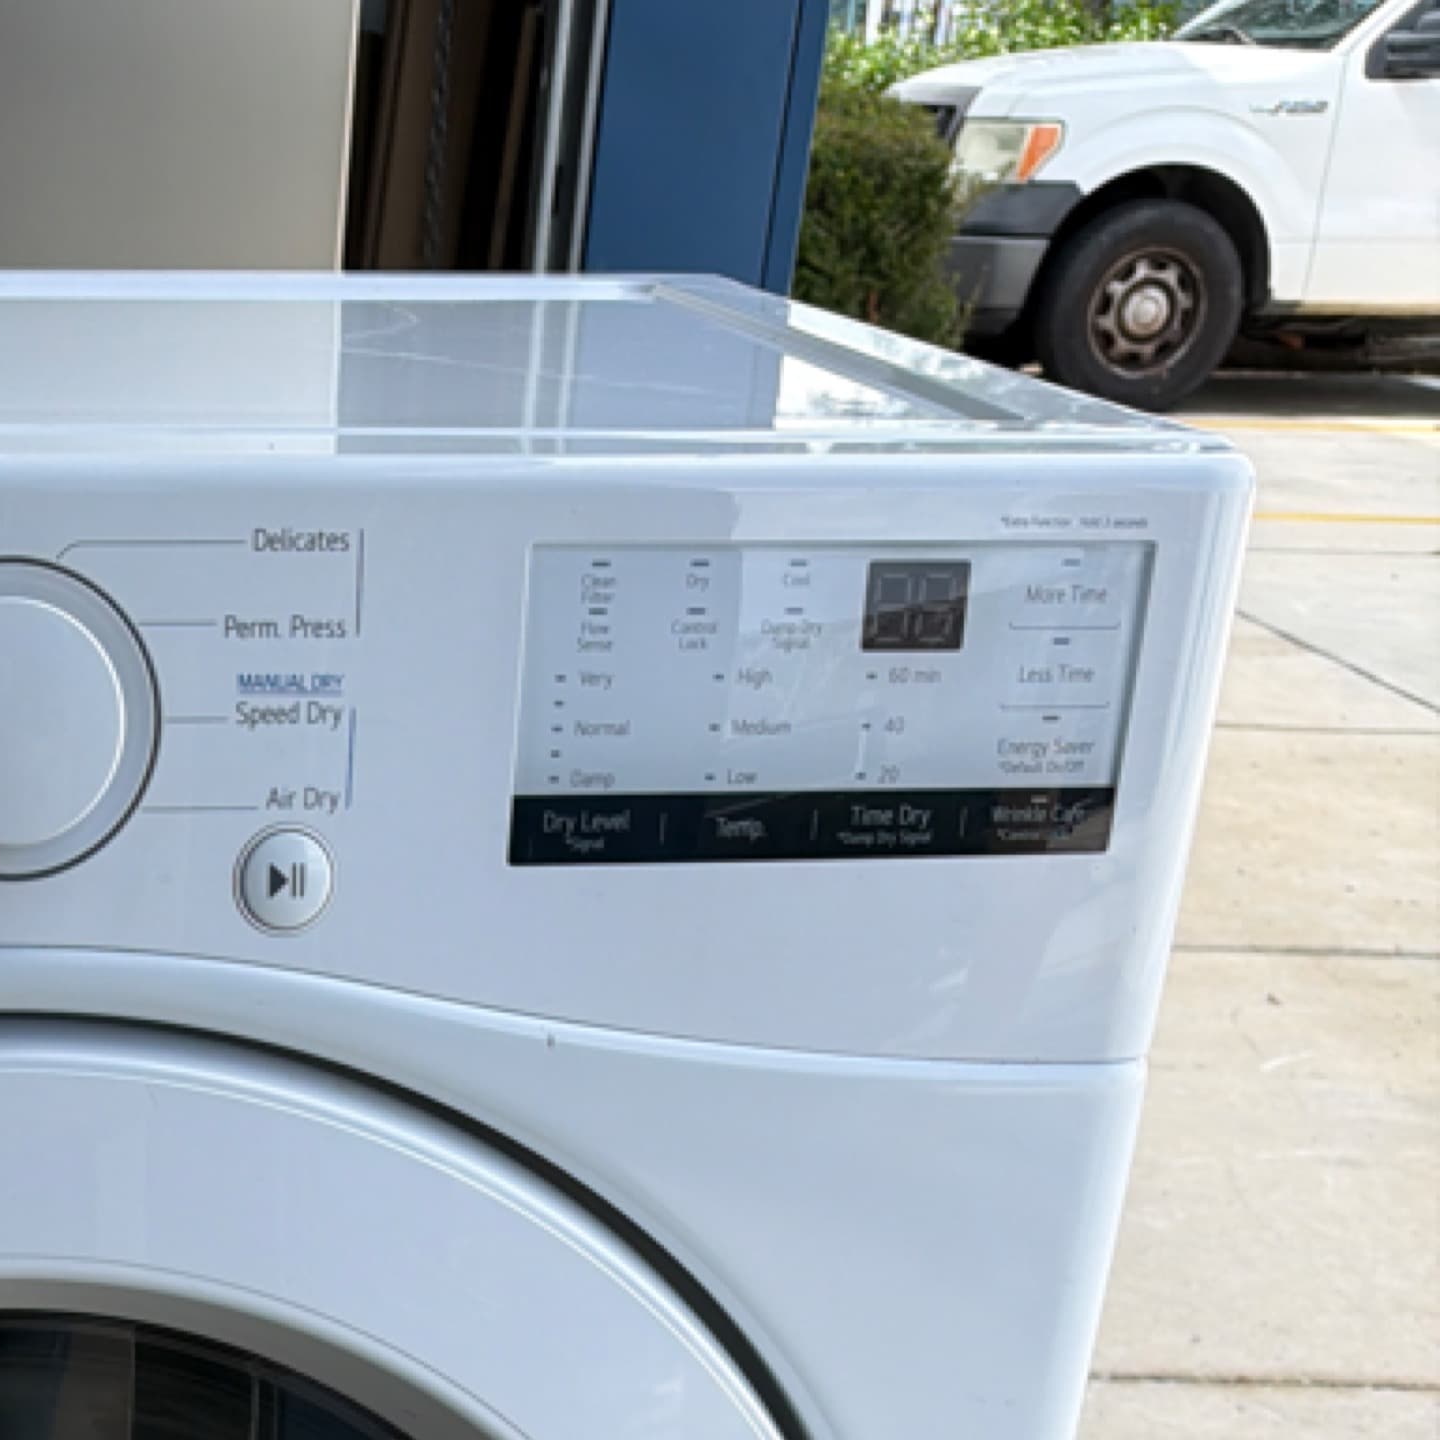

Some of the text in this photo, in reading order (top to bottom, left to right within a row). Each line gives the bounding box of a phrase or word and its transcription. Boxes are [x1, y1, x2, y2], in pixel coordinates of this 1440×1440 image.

[252, 528, 350, 552] Delicates
[686, 573, 710, 591] Dry
[1026, 584, 1108, 604] More Time
[224, 614, 346, 638] Perm. Press
[238, 673, 345, 690] MANUAL DRY
[580, 671, 614, 690] Very
[738, 668, 773, 690] High
[888, 667, 942, 684] 60 min
[1017, 663, 1097, 684] Less Time
[235, 701, 344, 731] Speed Dry
[574, 719, 631, 736] Normal
[732, 719, 791, 736] Medium
[998, 738, 1096, 762] Energy Saver
[570, 769, 615, 790] Damp
[727, 768, 758, 785] Low
[266, 787, 342, 815] Air Dry
[543, 809, 630, 838] Dry Level
[851, 804, 931, 830] Time Dry
